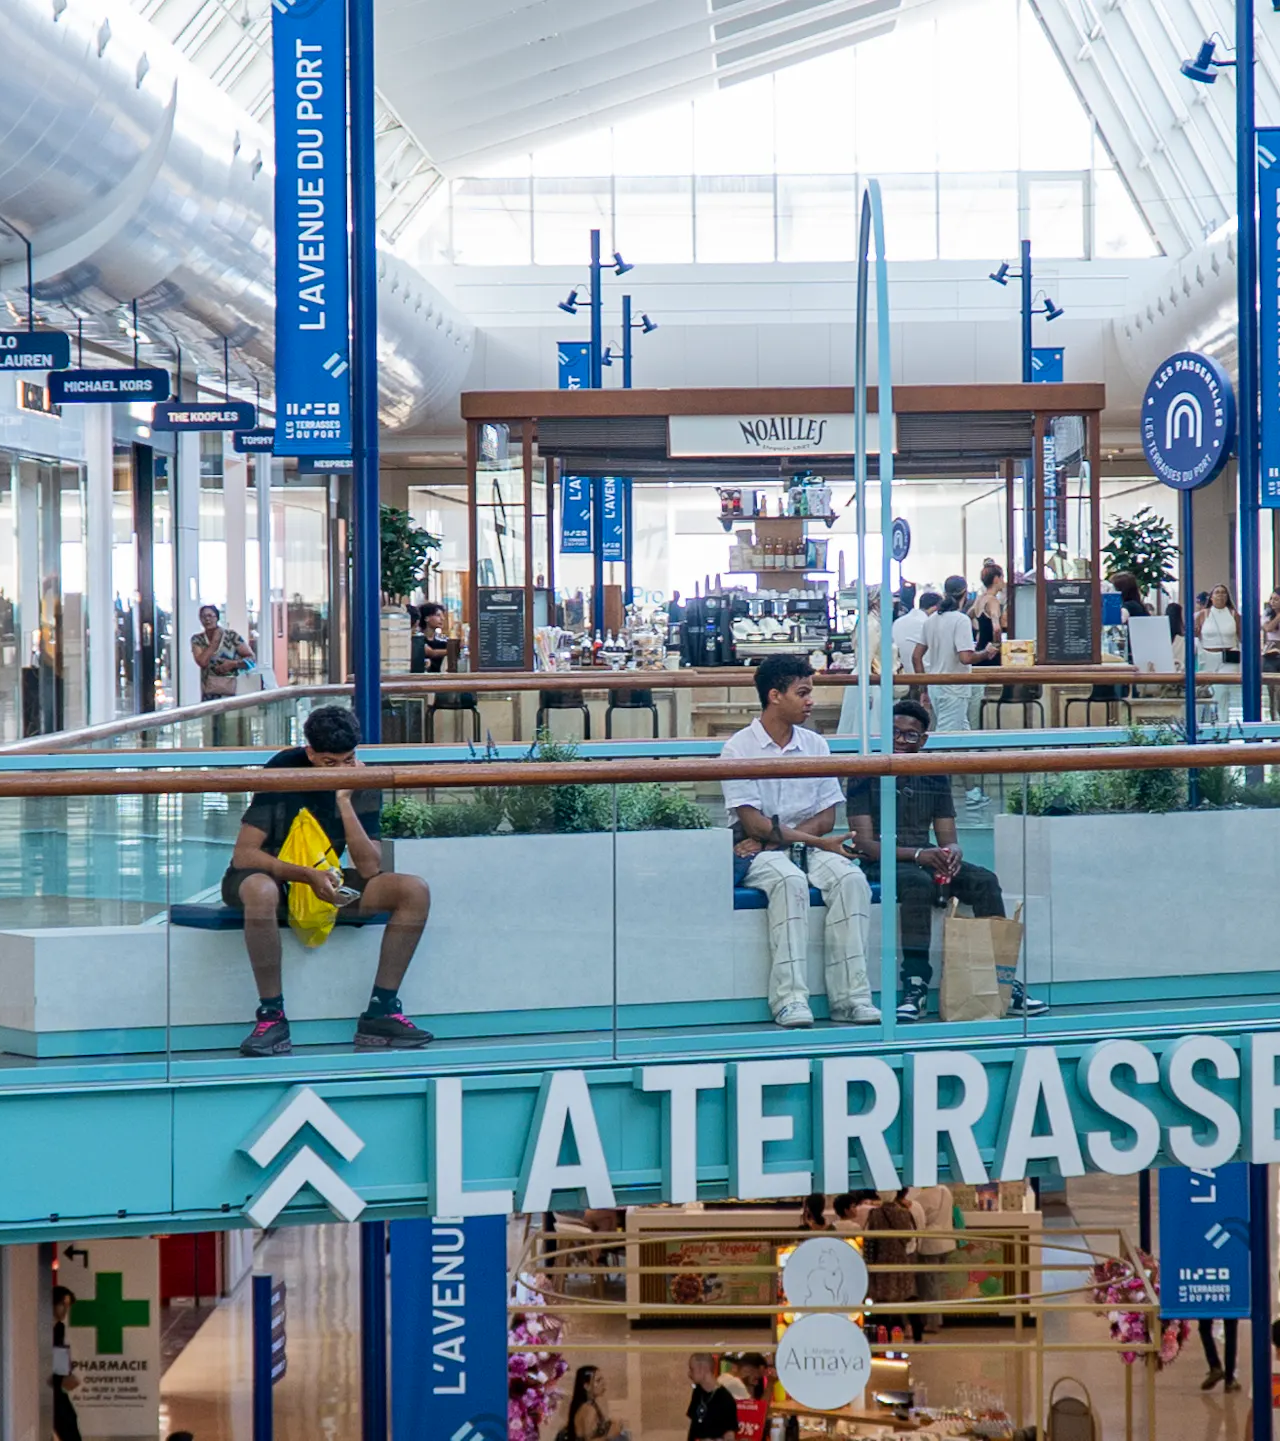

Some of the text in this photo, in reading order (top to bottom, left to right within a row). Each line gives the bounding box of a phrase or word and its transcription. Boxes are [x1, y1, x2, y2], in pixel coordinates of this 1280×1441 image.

[295, 38, 326, 331] L'AVENUE DU PORT
[63, 379, 154, 393] MICHAEL KORS
[1155, 359, 1224, 427] LES PASSERELLES
[167, 411, 239, 423] THE KOOPLES
[295, 420, 341, 430] TERRASSES
[284, 421, 295, 439] LES
[296, 429, 341, 439] DU PORT
[738, 416, 828, 447] NOAILLES
[241, 435, 274, 446] TOMMY
[1182, 471, 1194, 482] DU
[1193, 453, 1213, 478] PORT
[429, 1069, 617, 1217] LA
[1204, 1293, 1231, 1302] PORT
[71, 1360, 148, 1371] PHARMACIE
[784, 1347, 865, 1374] Amaya
